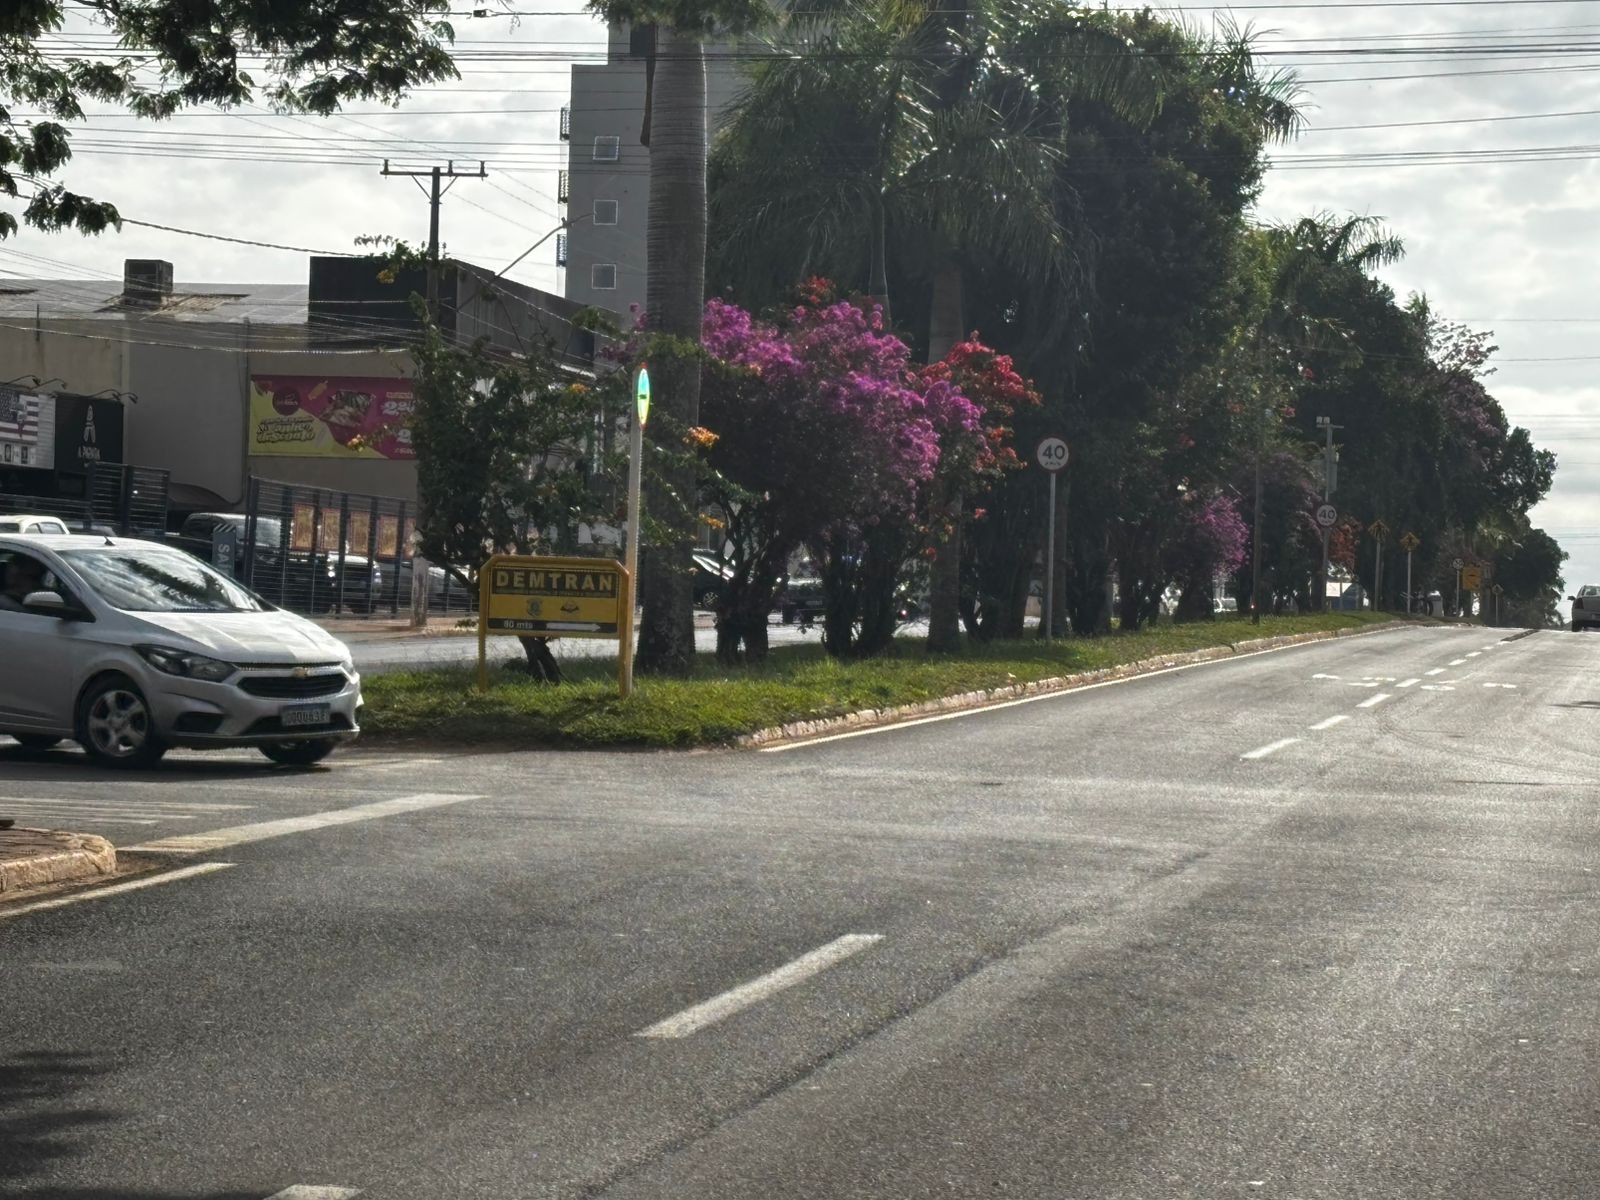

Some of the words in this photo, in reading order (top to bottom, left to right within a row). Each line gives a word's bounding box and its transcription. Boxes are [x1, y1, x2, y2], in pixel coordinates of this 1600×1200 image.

[1042, 444, 1066, 460] 40
[1319, 509, 1335, 519] 40
[496, 570, 613, 591] DEMTRAN
